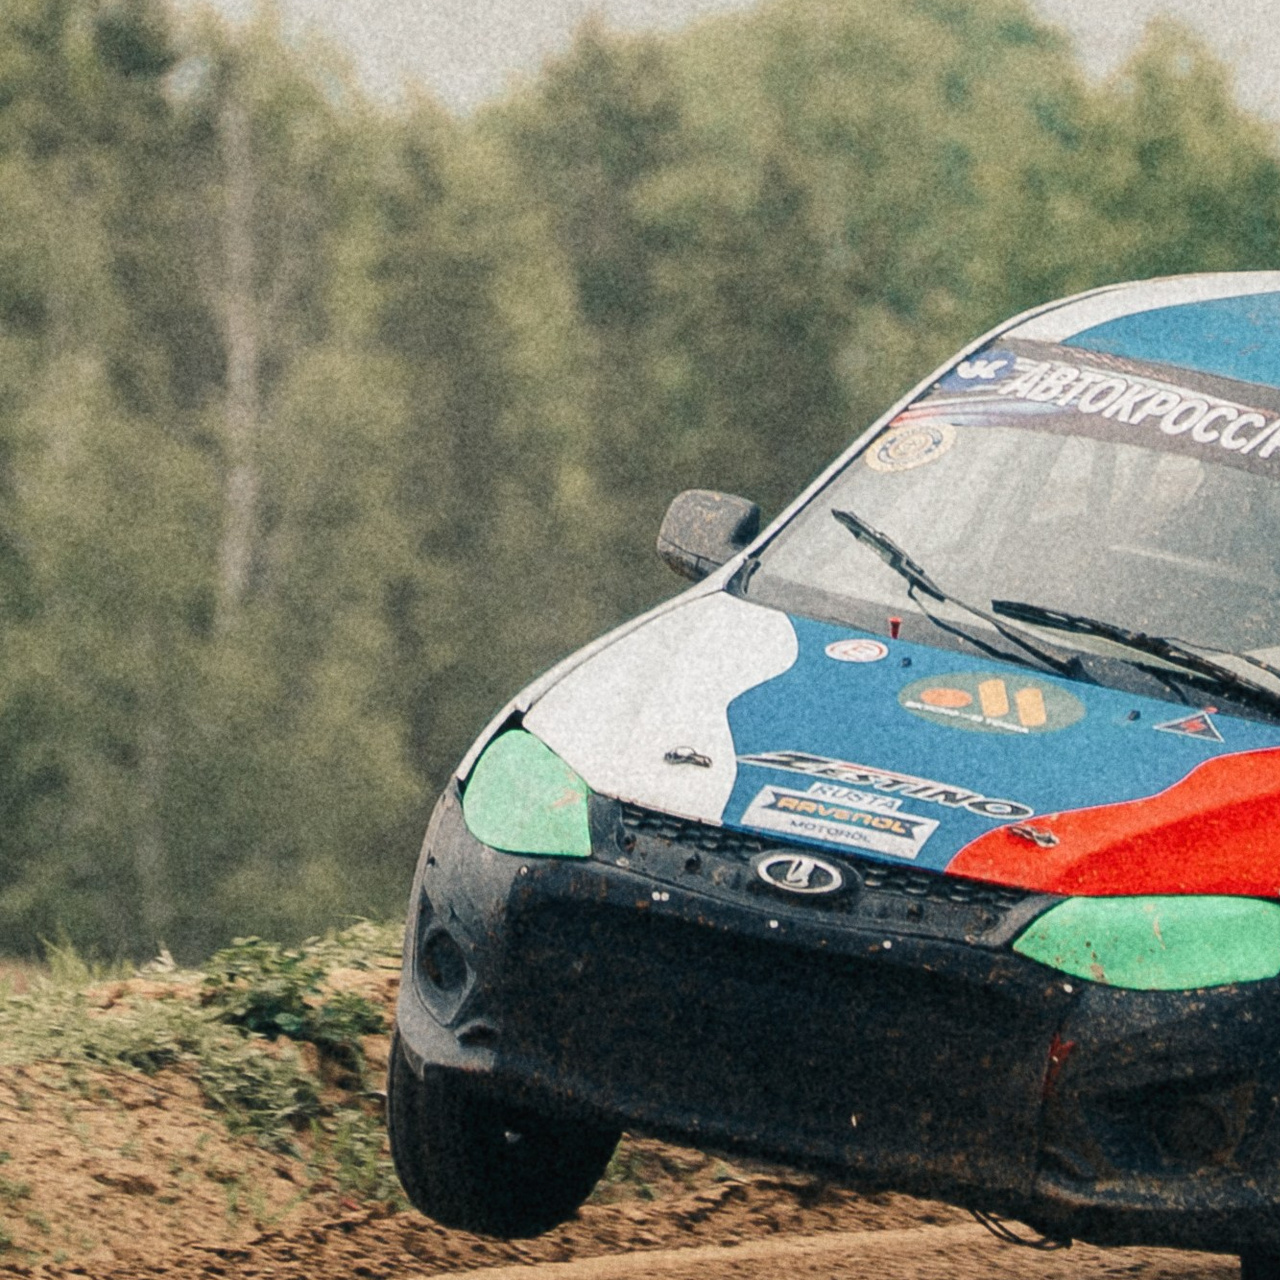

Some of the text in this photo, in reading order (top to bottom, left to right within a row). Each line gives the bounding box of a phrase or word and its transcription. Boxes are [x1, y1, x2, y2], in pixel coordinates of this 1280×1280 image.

[738, 751, 1034, 819] ZESTINO
[812, 783, 899, 812] RUSTA
[776, 796, 910, 834] RAVENOL
